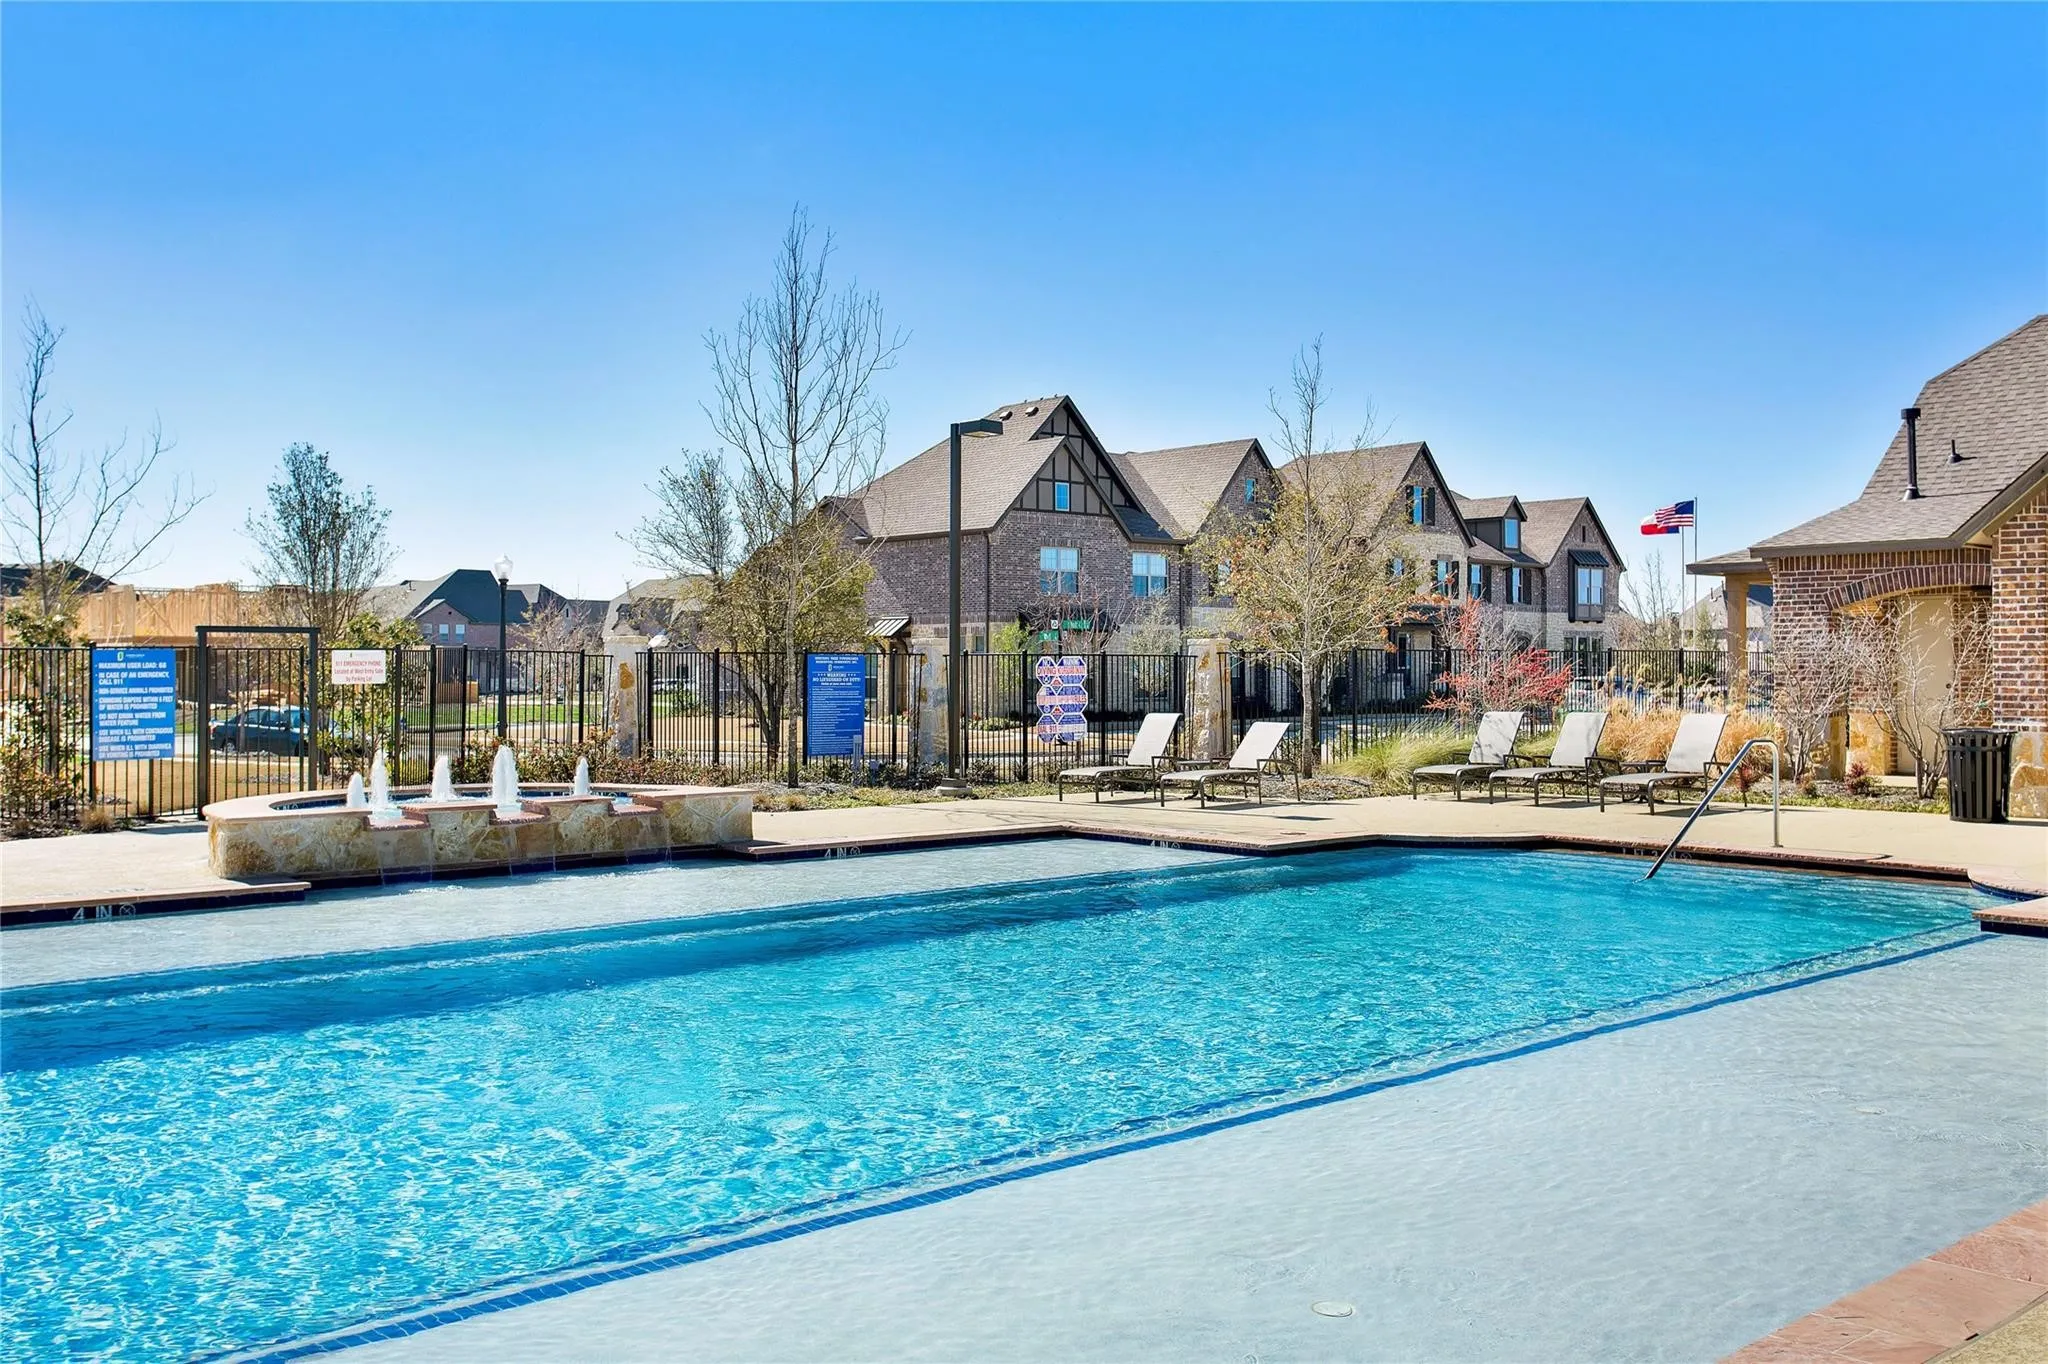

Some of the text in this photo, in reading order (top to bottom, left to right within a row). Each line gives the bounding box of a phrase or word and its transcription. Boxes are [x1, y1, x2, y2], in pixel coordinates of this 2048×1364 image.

[1037, 666, 1056, 676] DIVING
[824, 847, 847, 858] 4 IN
[72, 904, 113, 922] 4 IN
